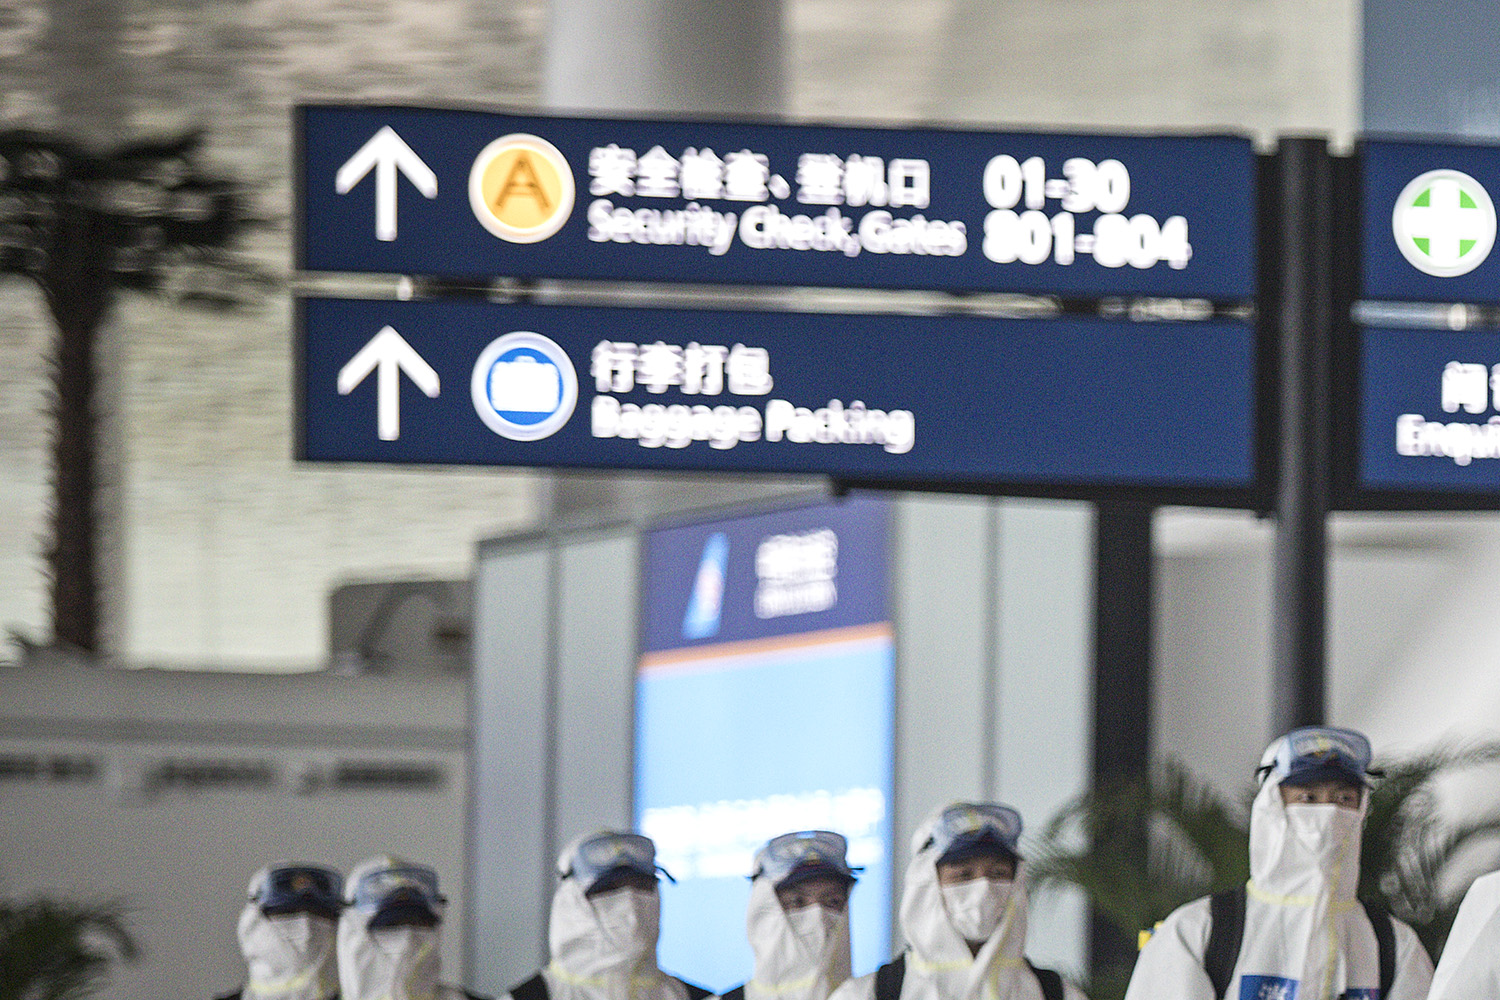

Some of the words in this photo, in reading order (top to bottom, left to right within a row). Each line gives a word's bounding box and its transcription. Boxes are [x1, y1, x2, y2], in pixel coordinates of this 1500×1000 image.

[493, 149, 553, 216] A
[983, 154, 1131, 213] 01-30
[587, 199, 738, 255] Security
[591, 340, 774, 395] 行李打包
[592, 395, 763, 450] Baggage
[765, 399, 916, 454] Packing
